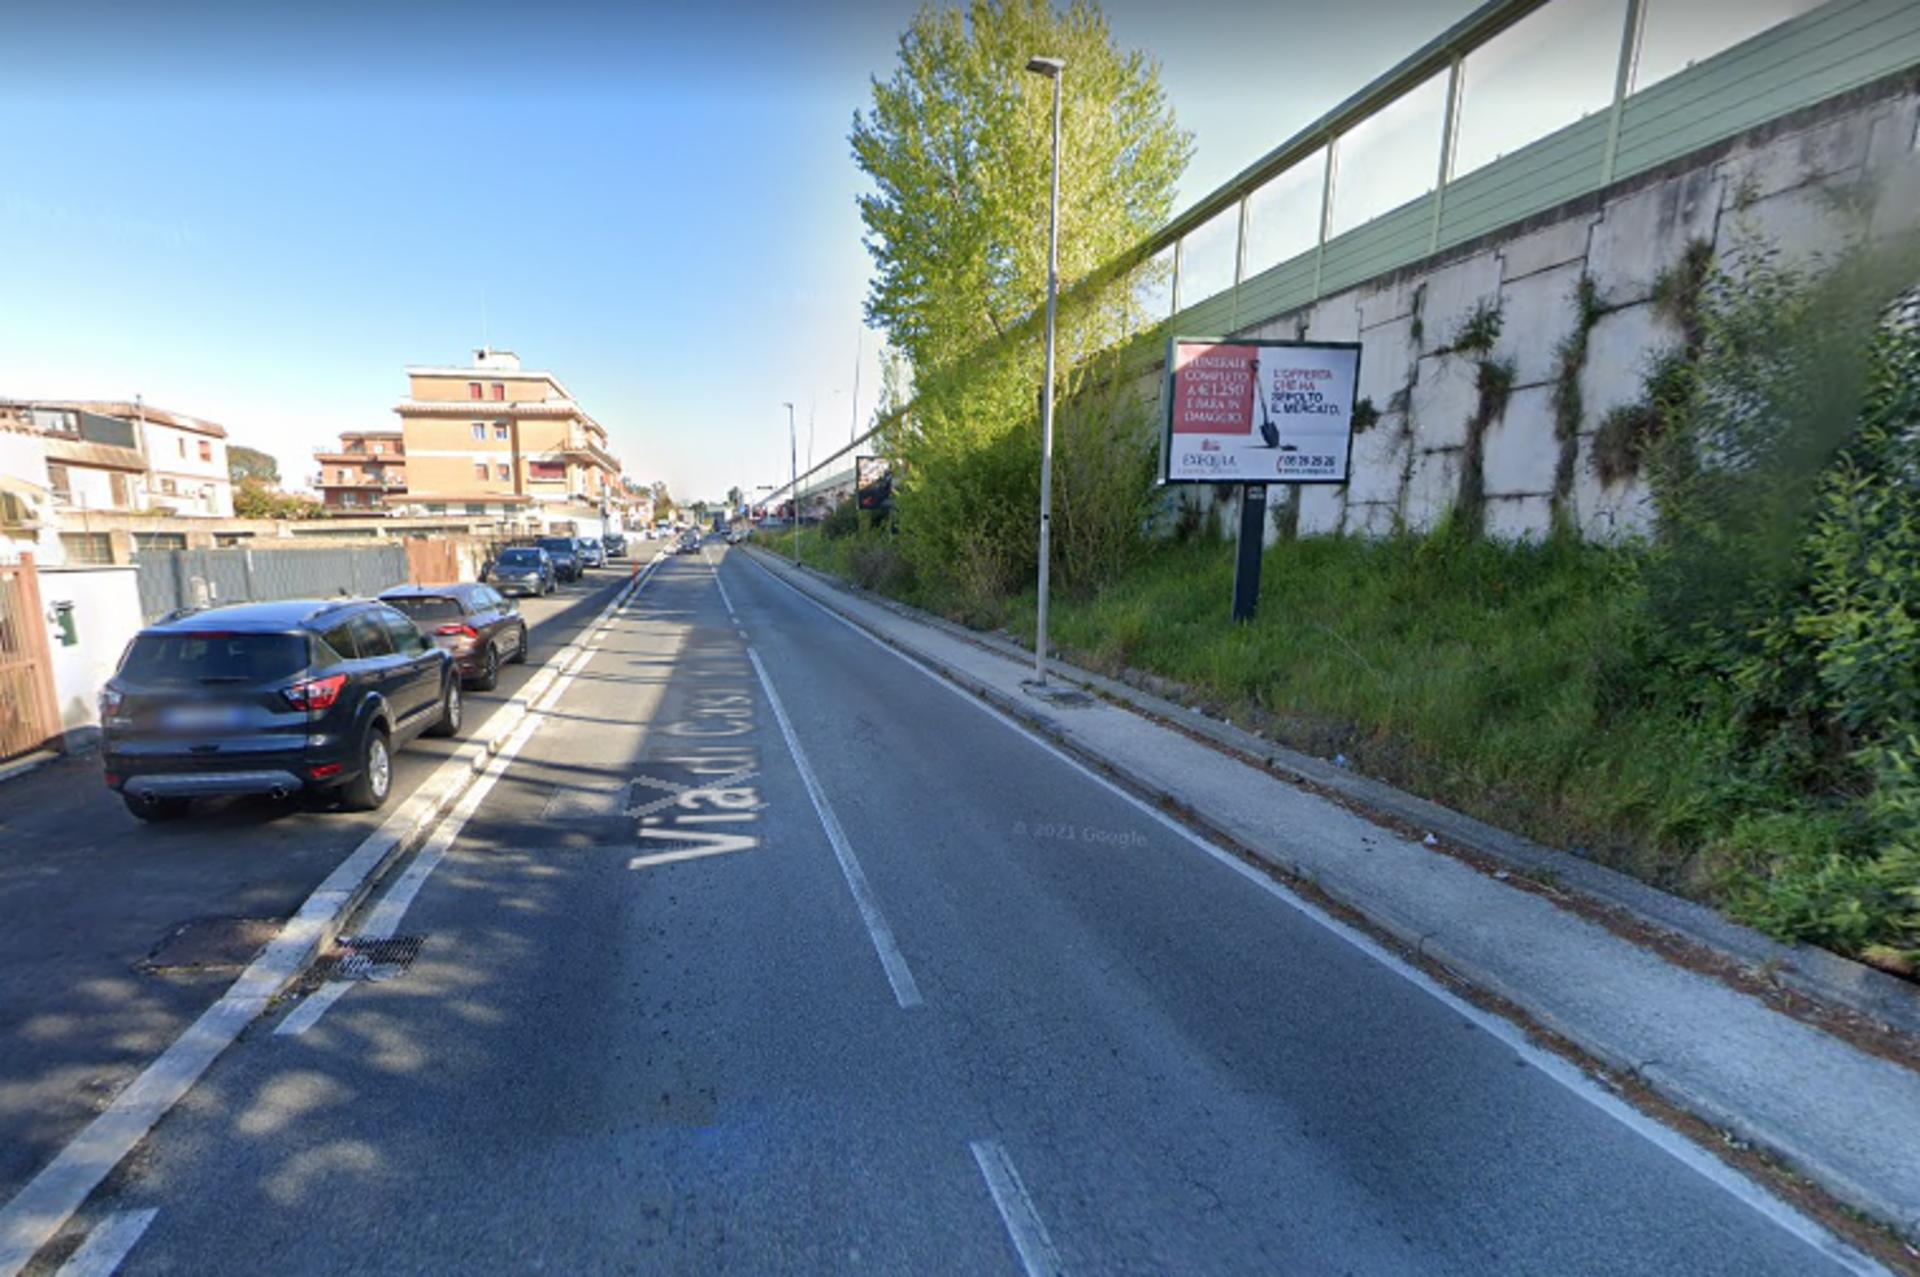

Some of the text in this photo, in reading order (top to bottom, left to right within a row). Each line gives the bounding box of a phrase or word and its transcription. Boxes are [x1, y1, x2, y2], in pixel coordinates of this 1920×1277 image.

[1185, 369, 1248, 382] COMPLETO
[1274, 368, 1334, 380] L'OFFERTA
[1186, 383, 1197, 396] A
[1198, 383, 1209, 396] €
[1274, 380, 1316, 391] CHE HA
[1228, 399, 1241, 410] IN
[1271, 402, 1281, 414] IL
